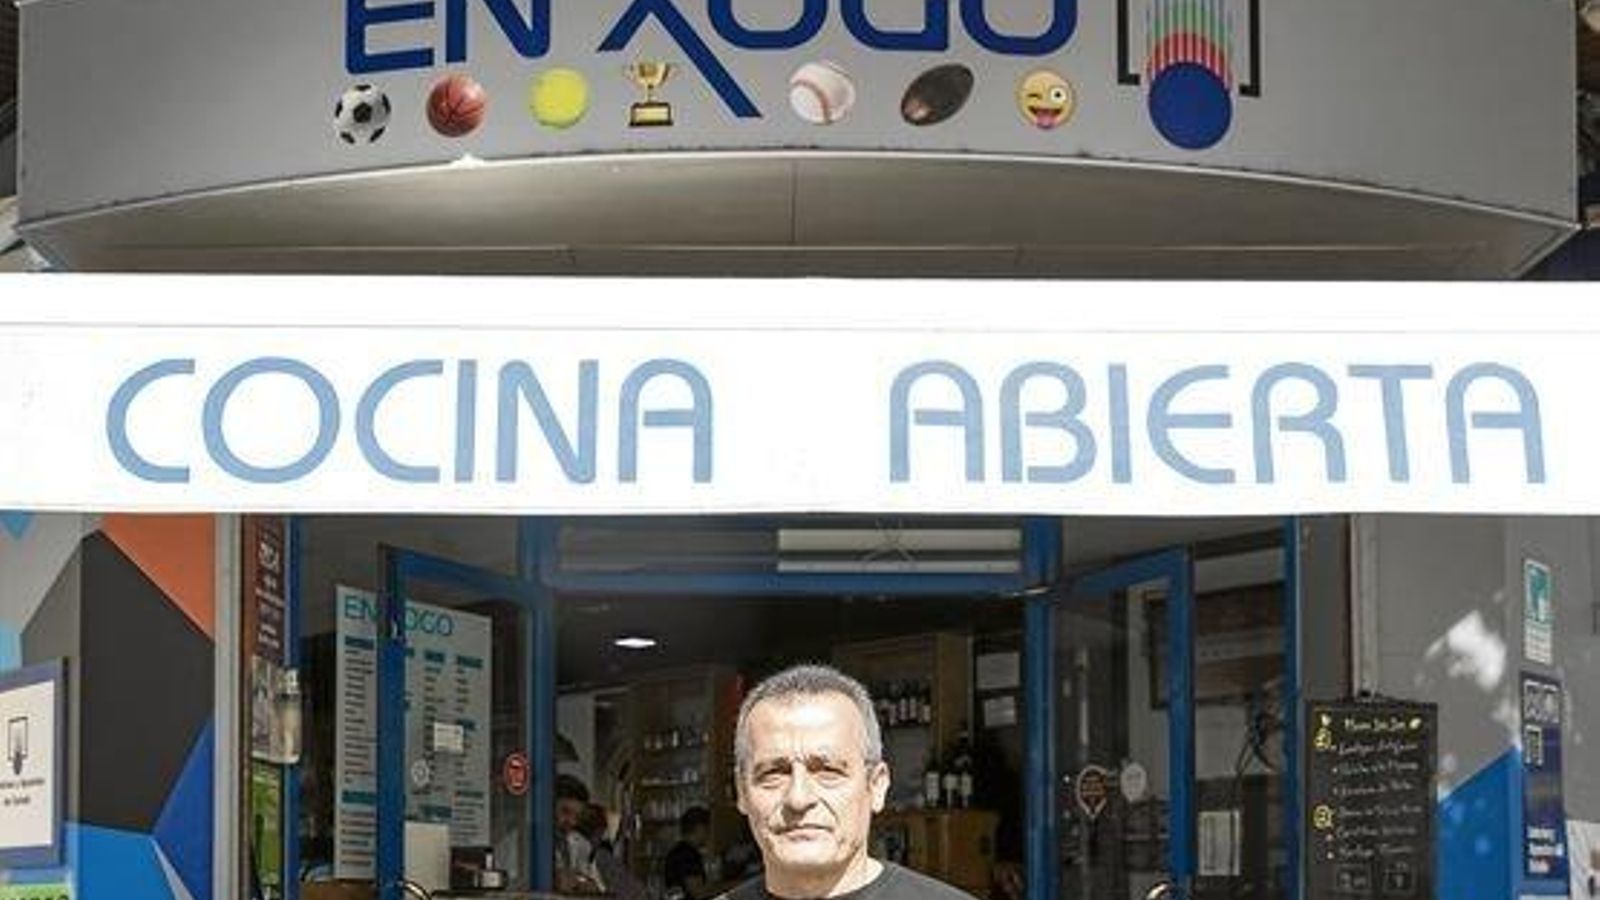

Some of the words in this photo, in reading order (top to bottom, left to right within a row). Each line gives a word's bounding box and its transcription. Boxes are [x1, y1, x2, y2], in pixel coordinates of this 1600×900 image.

[105, 356, 714, 484] COCINA
[889, 360, 1547, 484] ABIERTA
[403, 605, 454, 637] OGO
